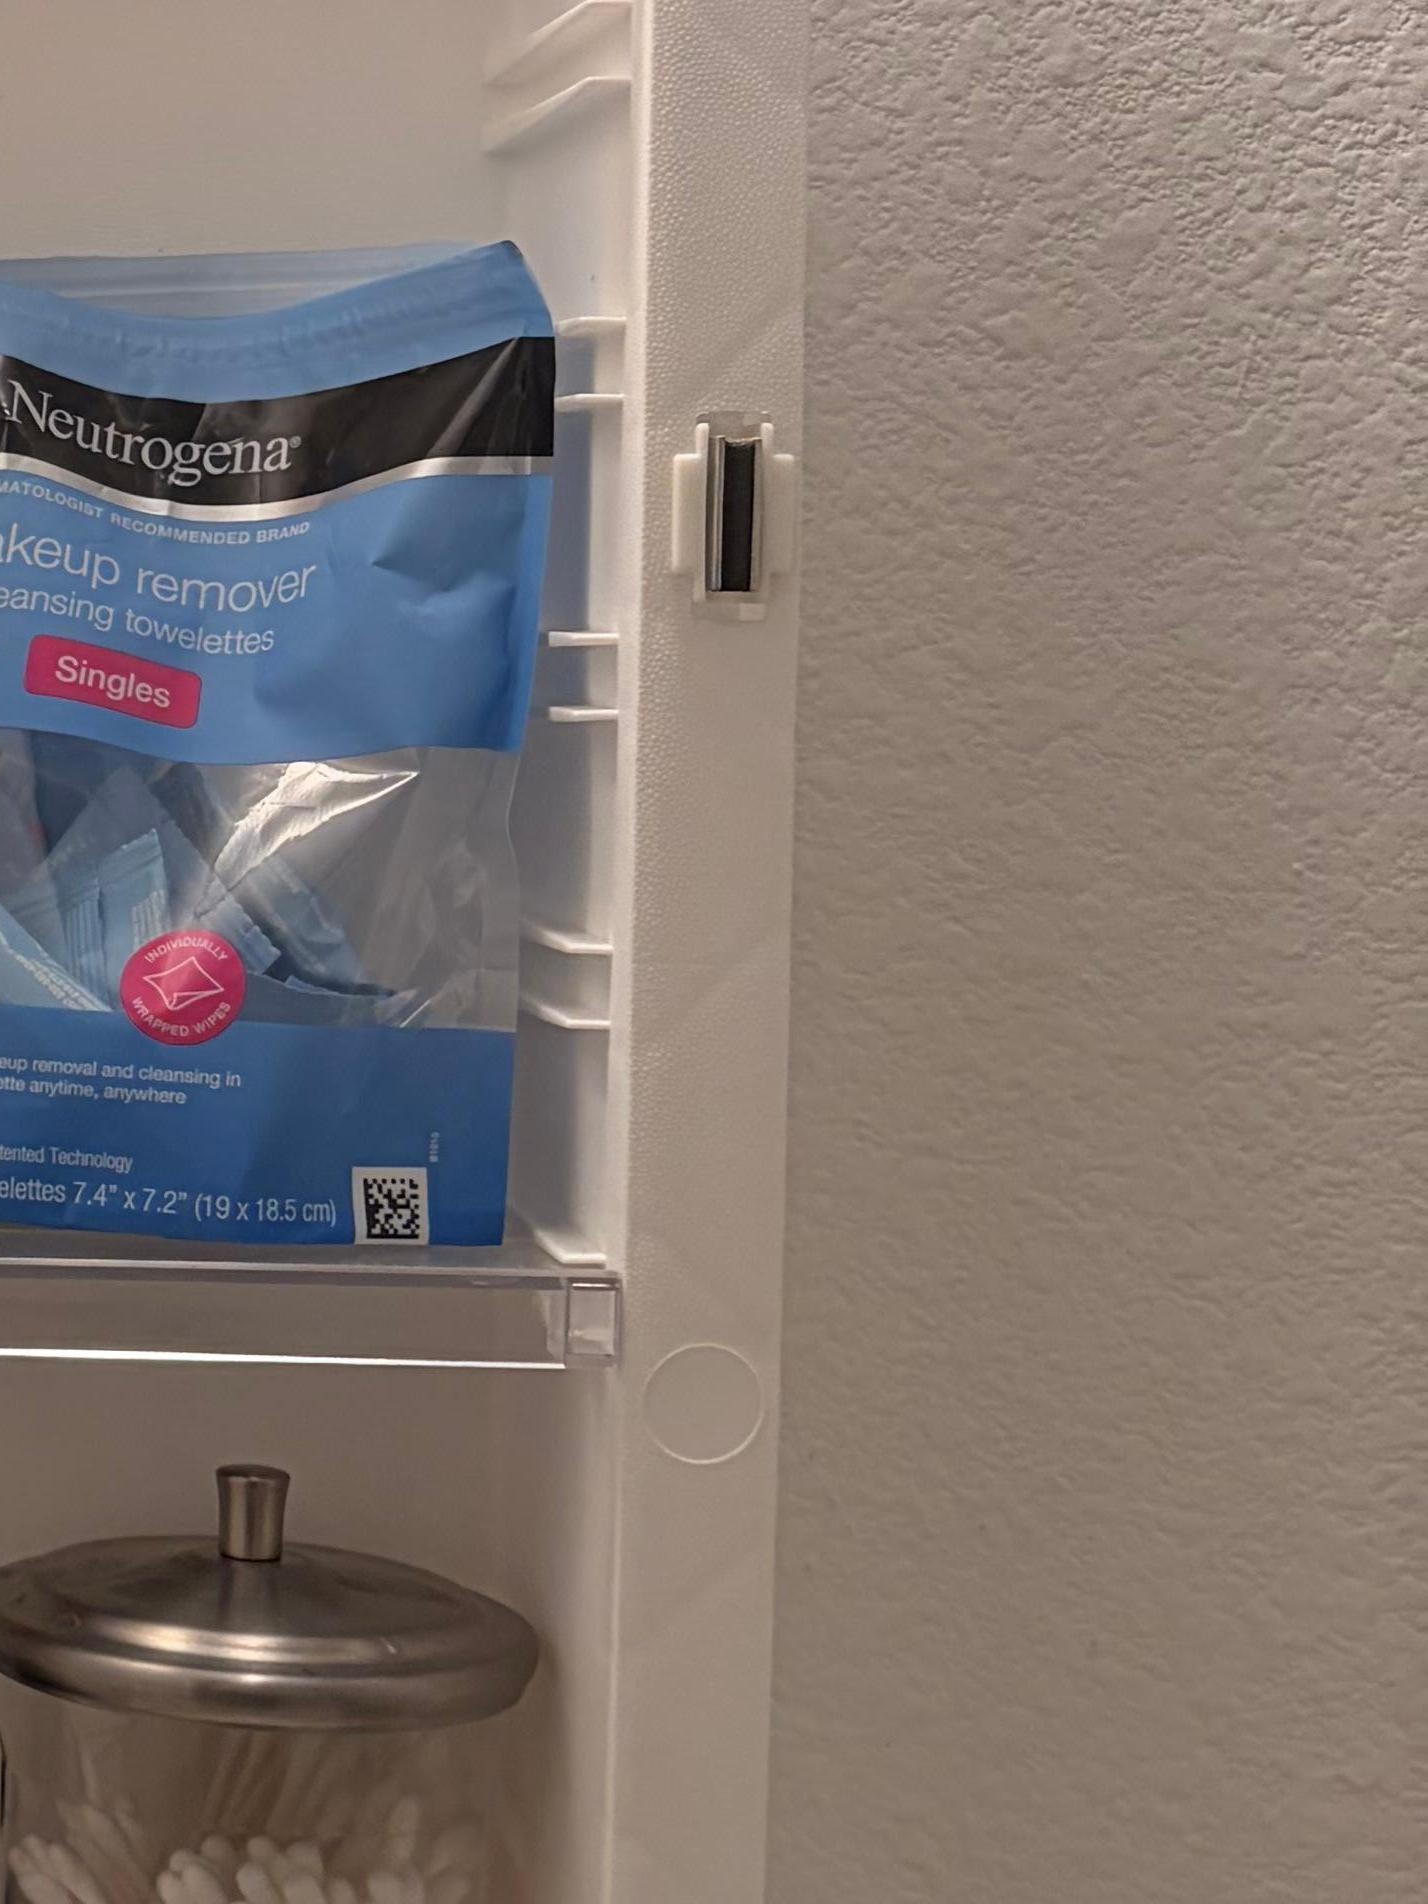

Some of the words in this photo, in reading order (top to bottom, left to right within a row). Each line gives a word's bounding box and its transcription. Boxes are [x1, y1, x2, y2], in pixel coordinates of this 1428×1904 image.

[5, 380, 292, 487] Neutrogena
[109, 513, 251, 545] RECOMMENDED
[254, 521, 311, 544] BRAND
[135, 564, 317, 613] remover
[124, 608, 276, 657] towelettes
[55, 654, 171, 710] Singles
[145, 936, 229, 964] INDIVIDUALLY
[131, 995, 190, 1038] WRAPPED
[193, 1001, 232, 1037] WIPES
[29, 1078, 98, 1099] anytime,
[103, 1084, 187, 1104] anywhere
[32, 1057, 97, 1076] removal
[102, 1063, 134, 1079] and
[138, 1065, 221, 1089] cleansing
[225, 1071, 241, 1086] in
[50, 1147, 133, 1174] Technology
[123, 1191, 136, 1209] x
[195, 1193, 230, 1221] (19
[236, 1202, 248, 1219] x
[255, 1198, 298, 1222] 18.5
[302, 1201, 336, 1228] cm)
